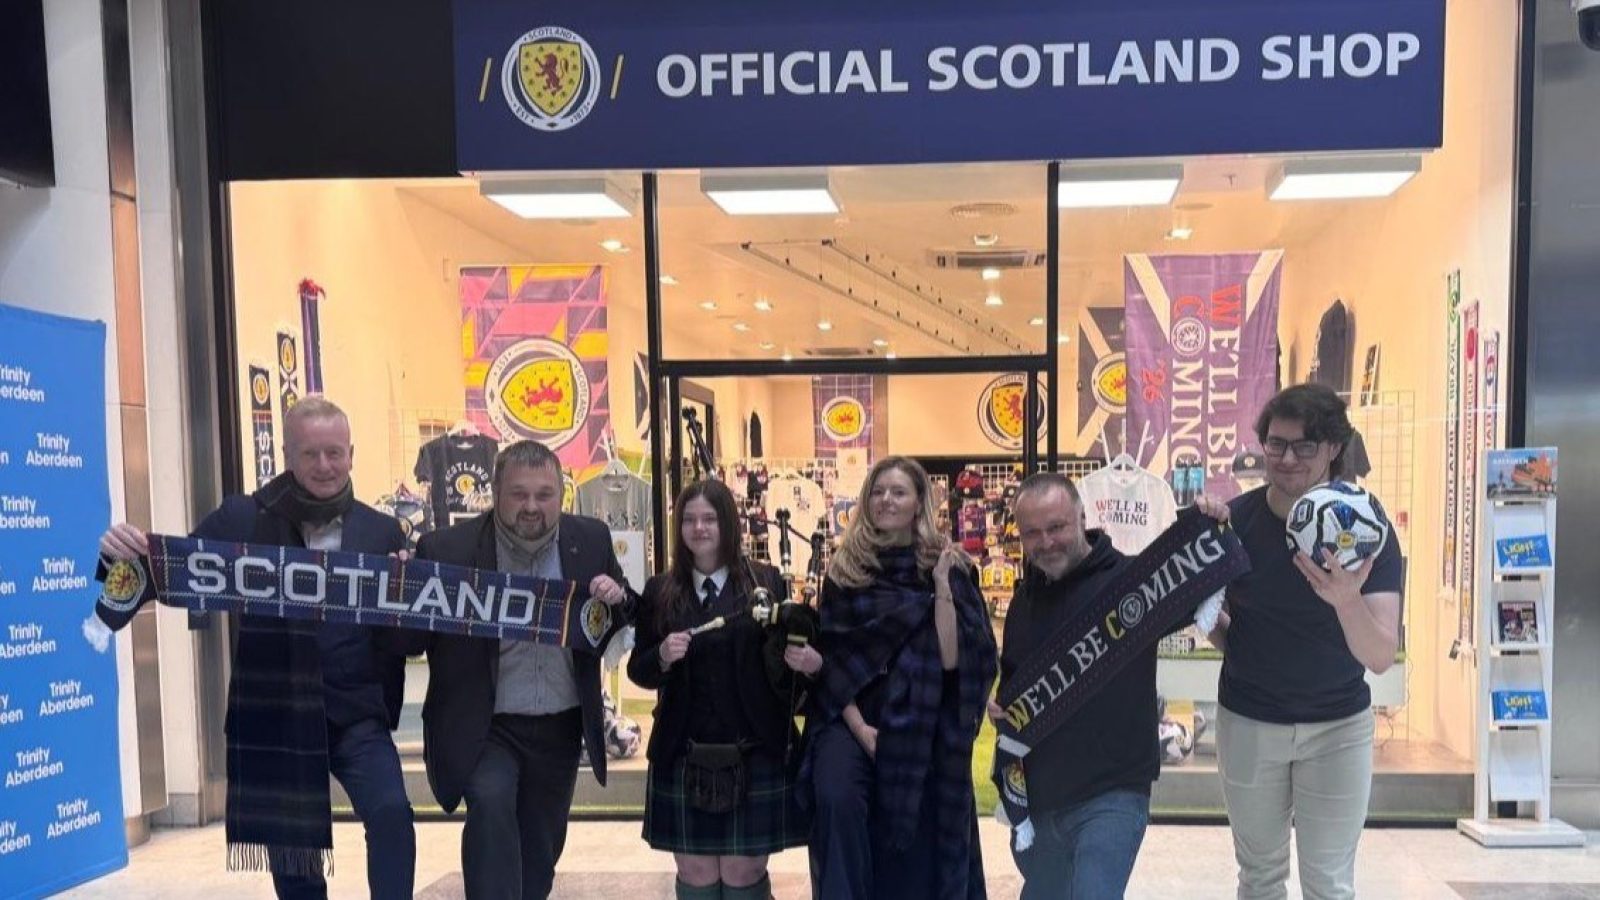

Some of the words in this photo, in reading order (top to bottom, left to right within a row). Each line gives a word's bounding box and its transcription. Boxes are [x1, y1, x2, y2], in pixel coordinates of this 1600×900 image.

[528, 27, 572, 40] SCOTLAND
[656, 49, 909, 98] OFFICIAL
[927, 37, 1240, 91] SCOTLAND
[1261, 32, 1421, 81] SHOP
[1208, 284, 1243, 414] WE'LL
[0, 364, 31, 386] rinity
[0, 384, 45, 402] erdeen
[36, 432, 70, 453] Trinity
[1207, 423, 1238, 478] BE
[26, 449, 82, 468] Aberdeen
[1, 495, 36, 514] Trinity
[1095, 499, 1131, 511] WE'LL
[0, 513, 50, 529] berdeen
[42, 557, 75, 577] Trinity
[32, 574, 87, 592] Aberdeen
[187, 551, 536, 625] SCOTLAND
[8, 621, 43, 641] Trinity
[0, 638, 56, 659] Aberdeen
[49, 679, 82, 699] Trinity
[1003, 662, 1076, 732] WE'LL
[1067, 626, 1108, 673] BE
[39, 693, 94, 717] Aberdeen
[15, 747, 51, 768] Trinity
[5, 761, 64, 788] Aberdeen
[56, 799, 89, 819] Trinity
[46, 811, 101, 839] Aberdeen
[0, 833, 31, 854] deen
